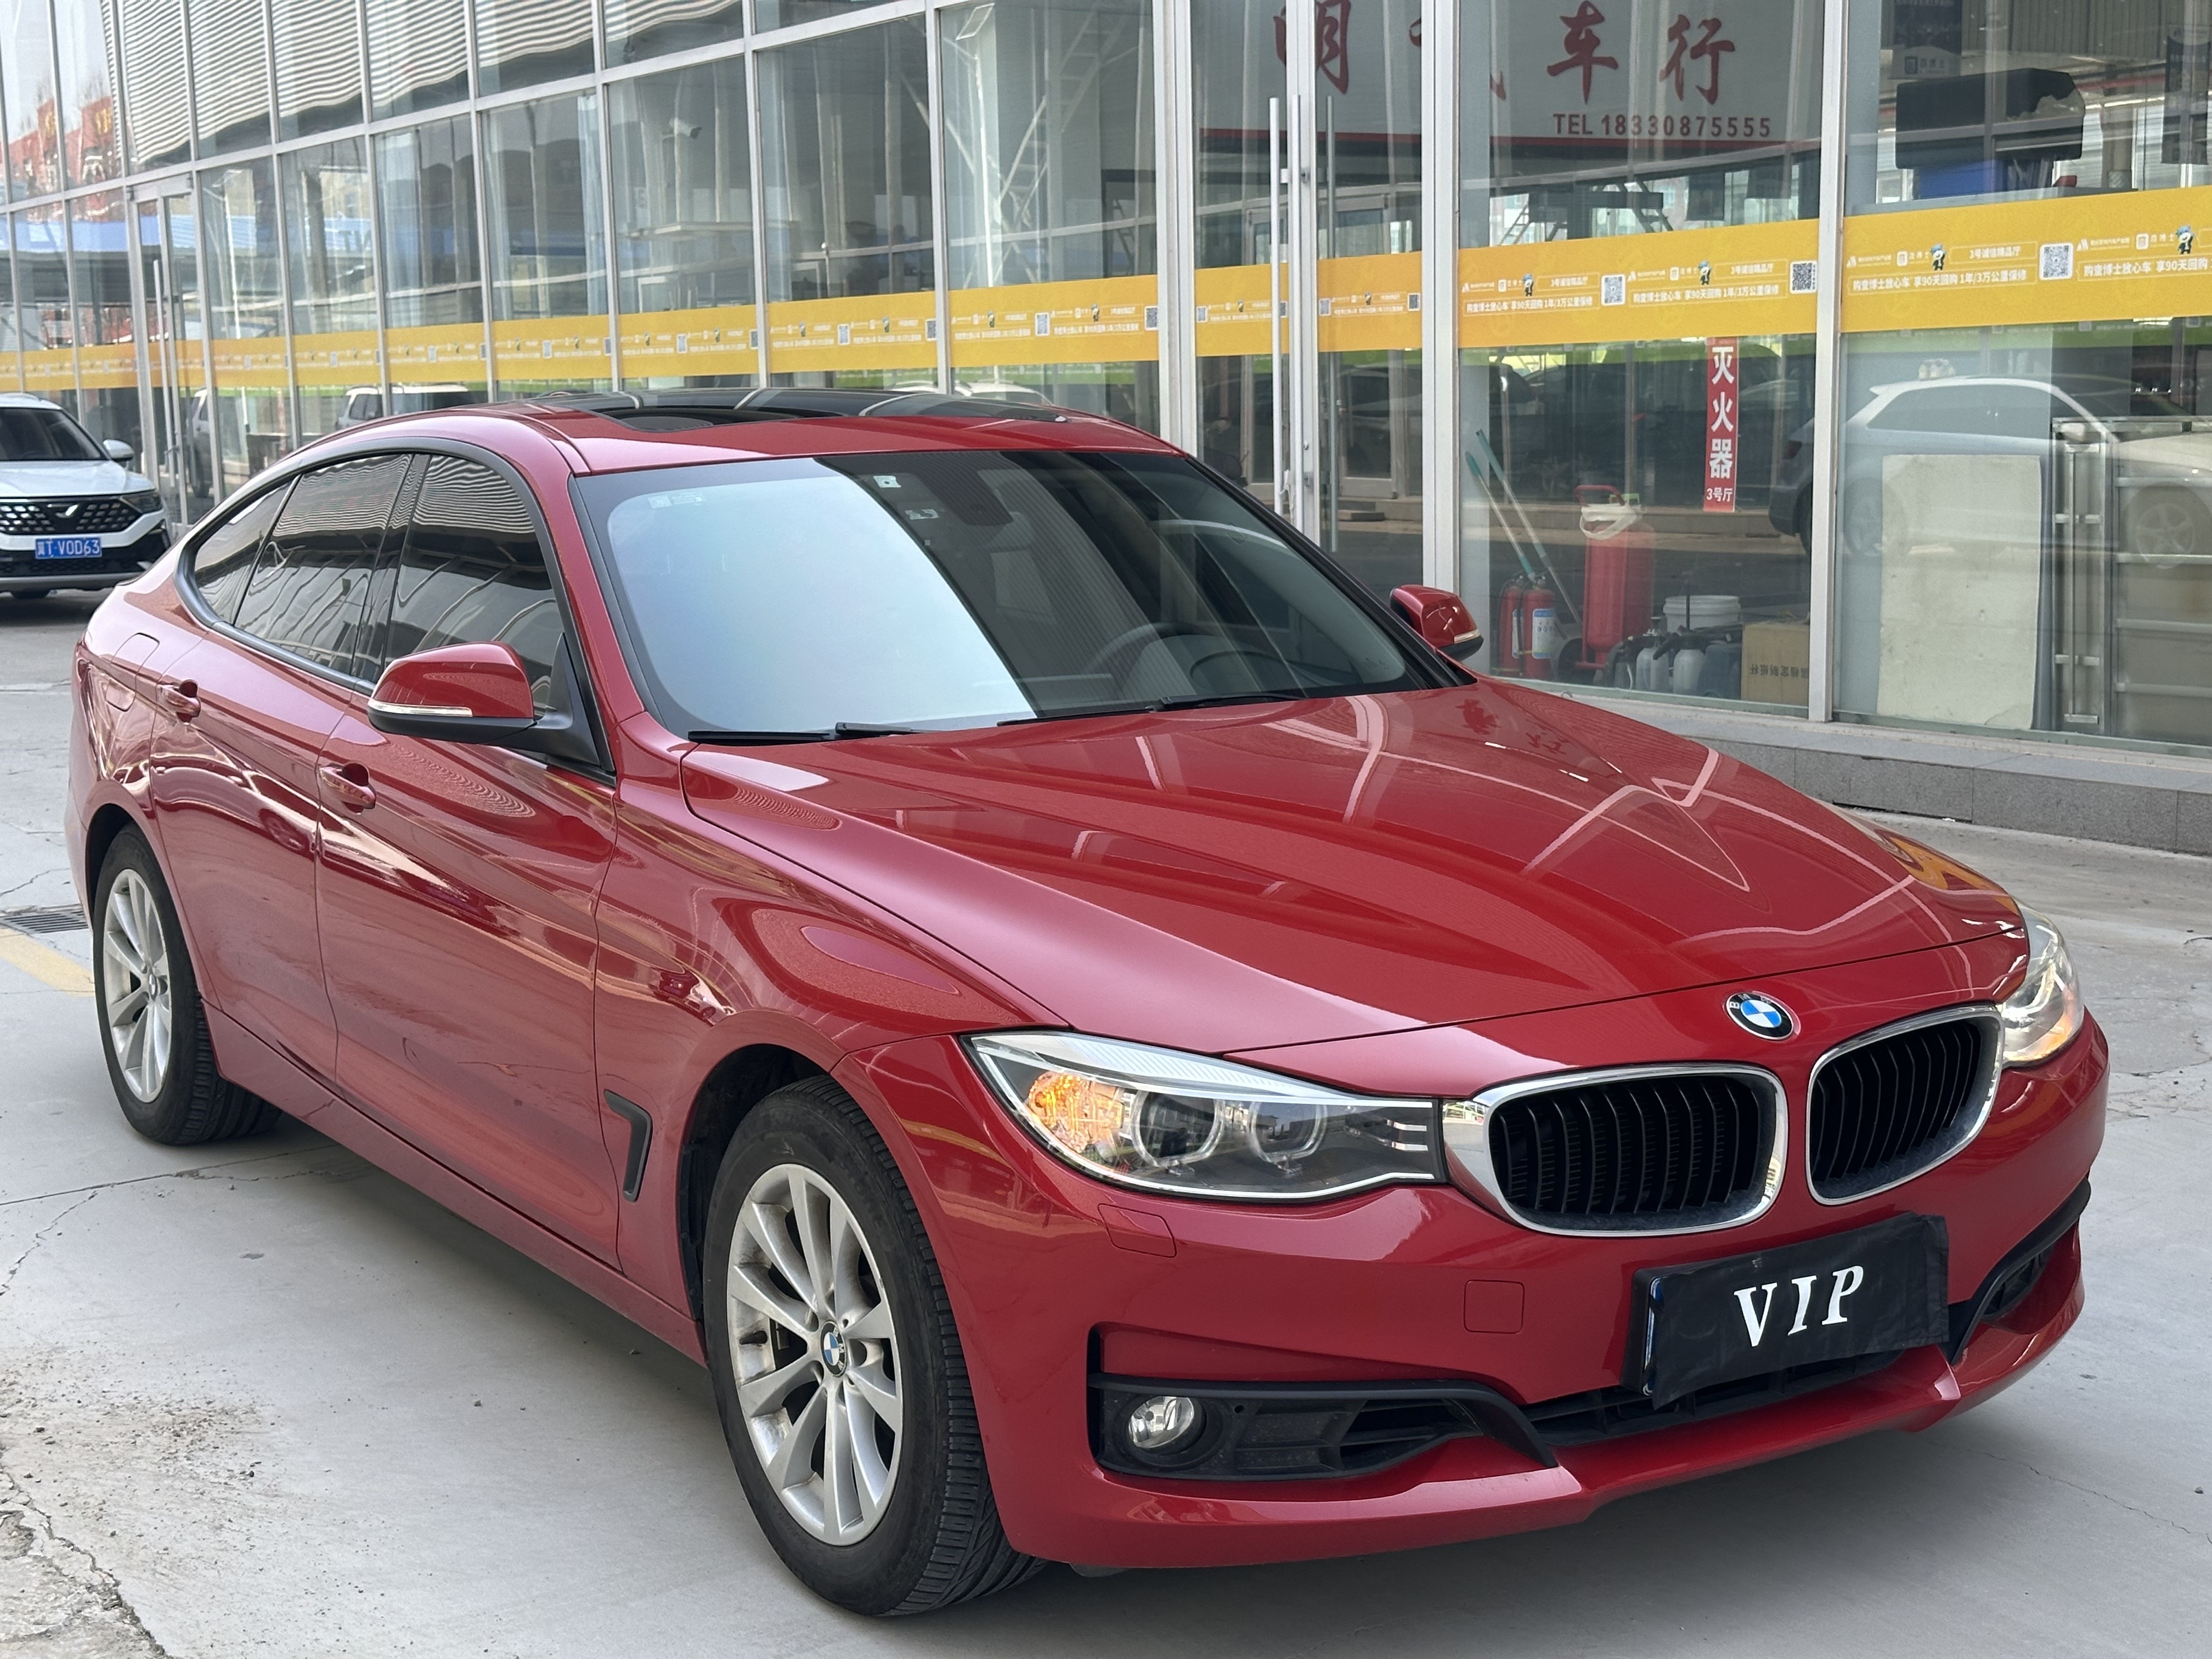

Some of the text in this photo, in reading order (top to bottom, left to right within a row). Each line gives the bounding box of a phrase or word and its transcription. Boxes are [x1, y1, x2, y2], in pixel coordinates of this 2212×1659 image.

[1553, 114, 1770, 137] TEL 18330875555
[1709, 347, 1734, 478] 灭火器
[1706, 488, 1733, 502] 3号厅
[1733, 1265, 1864, 1347] VIP
[833, 1327, 845, 1370] BMW
